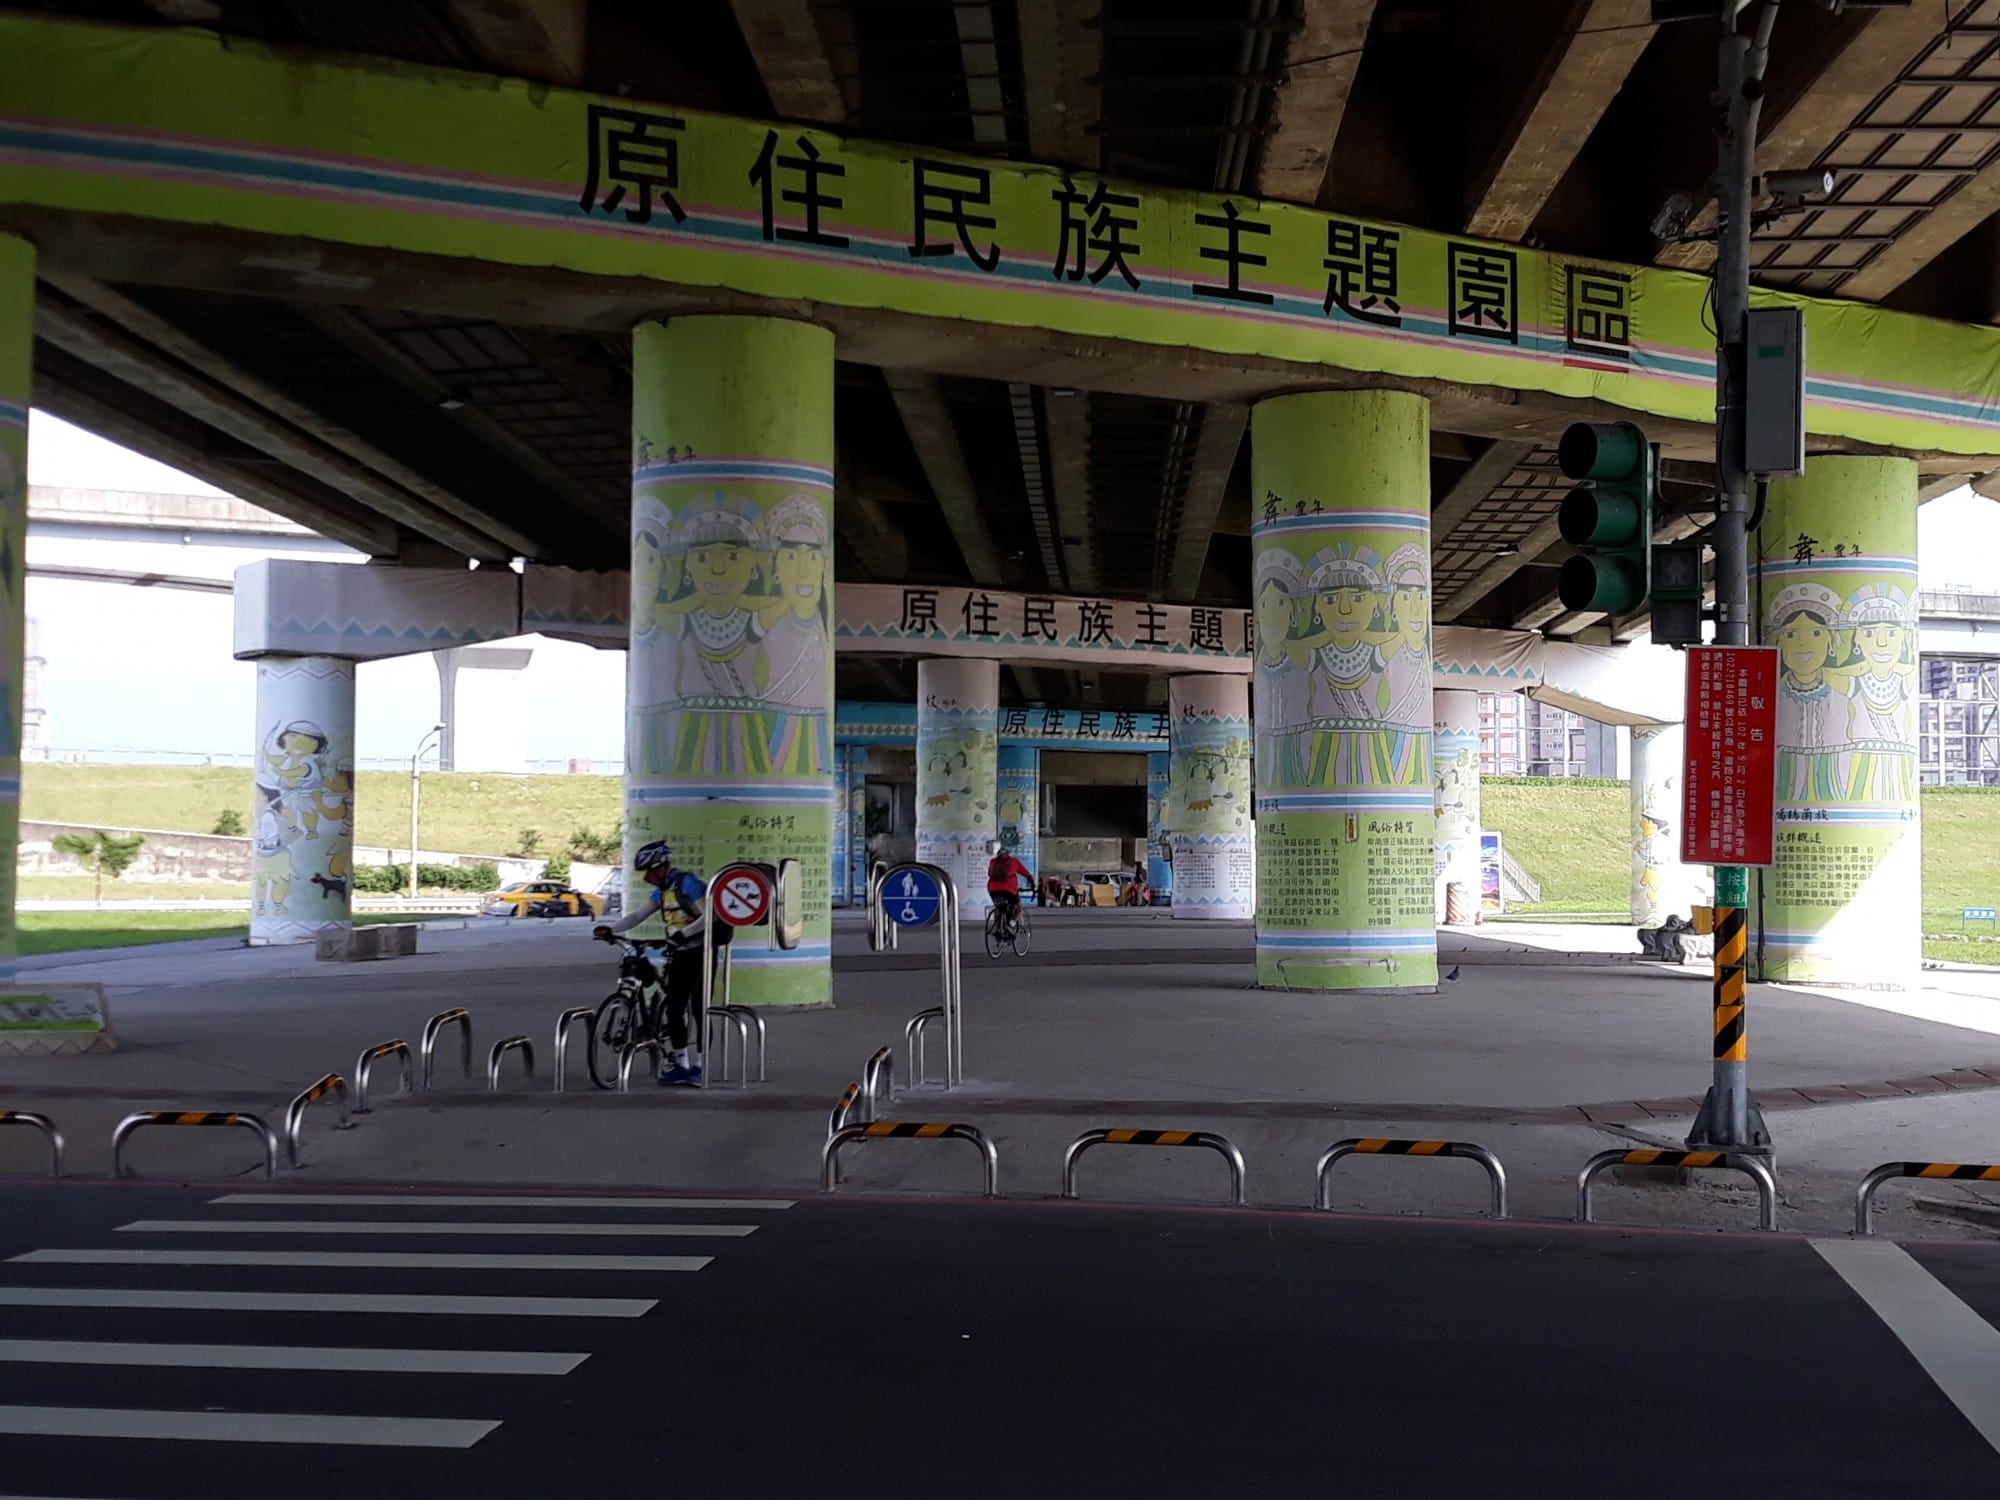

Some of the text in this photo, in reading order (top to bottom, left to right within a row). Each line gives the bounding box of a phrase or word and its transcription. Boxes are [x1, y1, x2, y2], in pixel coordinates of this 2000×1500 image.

[579, 102, 1634, 358] 原住民族主題園區
